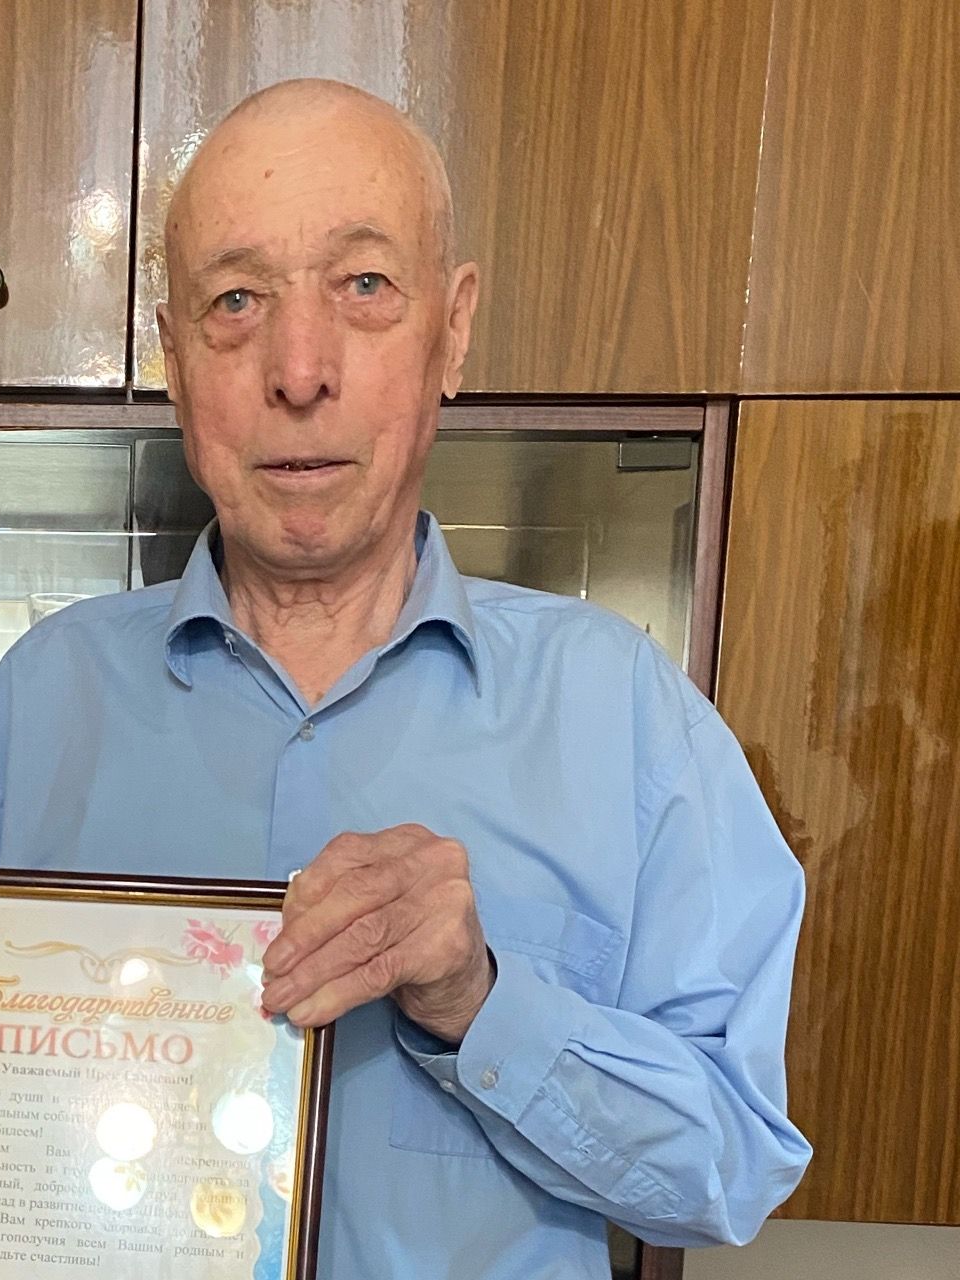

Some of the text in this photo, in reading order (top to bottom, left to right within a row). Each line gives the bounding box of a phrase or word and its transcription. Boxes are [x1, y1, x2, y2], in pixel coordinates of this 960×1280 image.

[1, 1063, 81, 1078] Уважаемый
[9, 1091, 43, 1104] души
[52, 1095, 60, 1103] и
[45, 1145, 71, 1157] Вам
[45, 1164, 53, 1174] и
[19, 1200, 26, 1208] в
[29, 1199, 85, 1212] развитие
[0, 1213, 25, 1225] Вам
[35, 1216, 91, 1230] крепкого
[77, 1238, 106, 1249] всем
[118, 1239, 163, 1253] Вашим
[174, 1245, 225, 1258] родным
[236, 1251, 244, 1260] и
[30, 1252, 101, 1267] счастливы!
